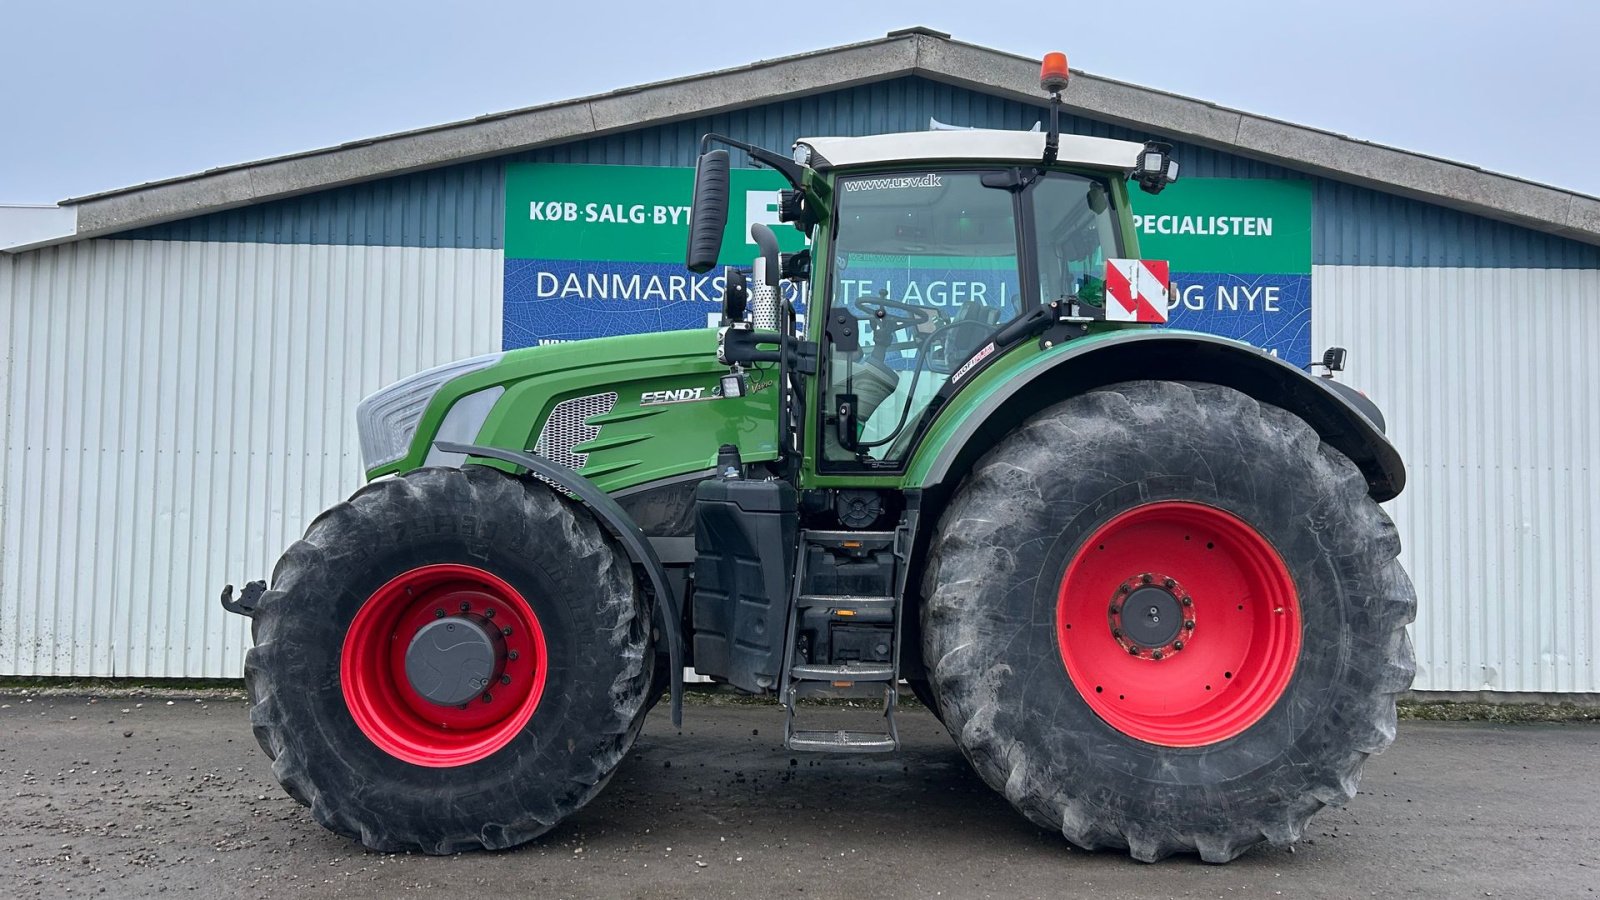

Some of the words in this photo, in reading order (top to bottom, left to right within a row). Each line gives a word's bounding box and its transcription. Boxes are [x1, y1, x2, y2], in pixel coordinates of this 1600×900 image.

[844, 174, 942, 192] www.usv.dk
[1132, 214, 1273, 237] PECIALISTEN
[537, 272, 726, 302] DANMARKS
[1217, 286, 1280, 312] NYE
[641, 387, 705, 404] FENDT
